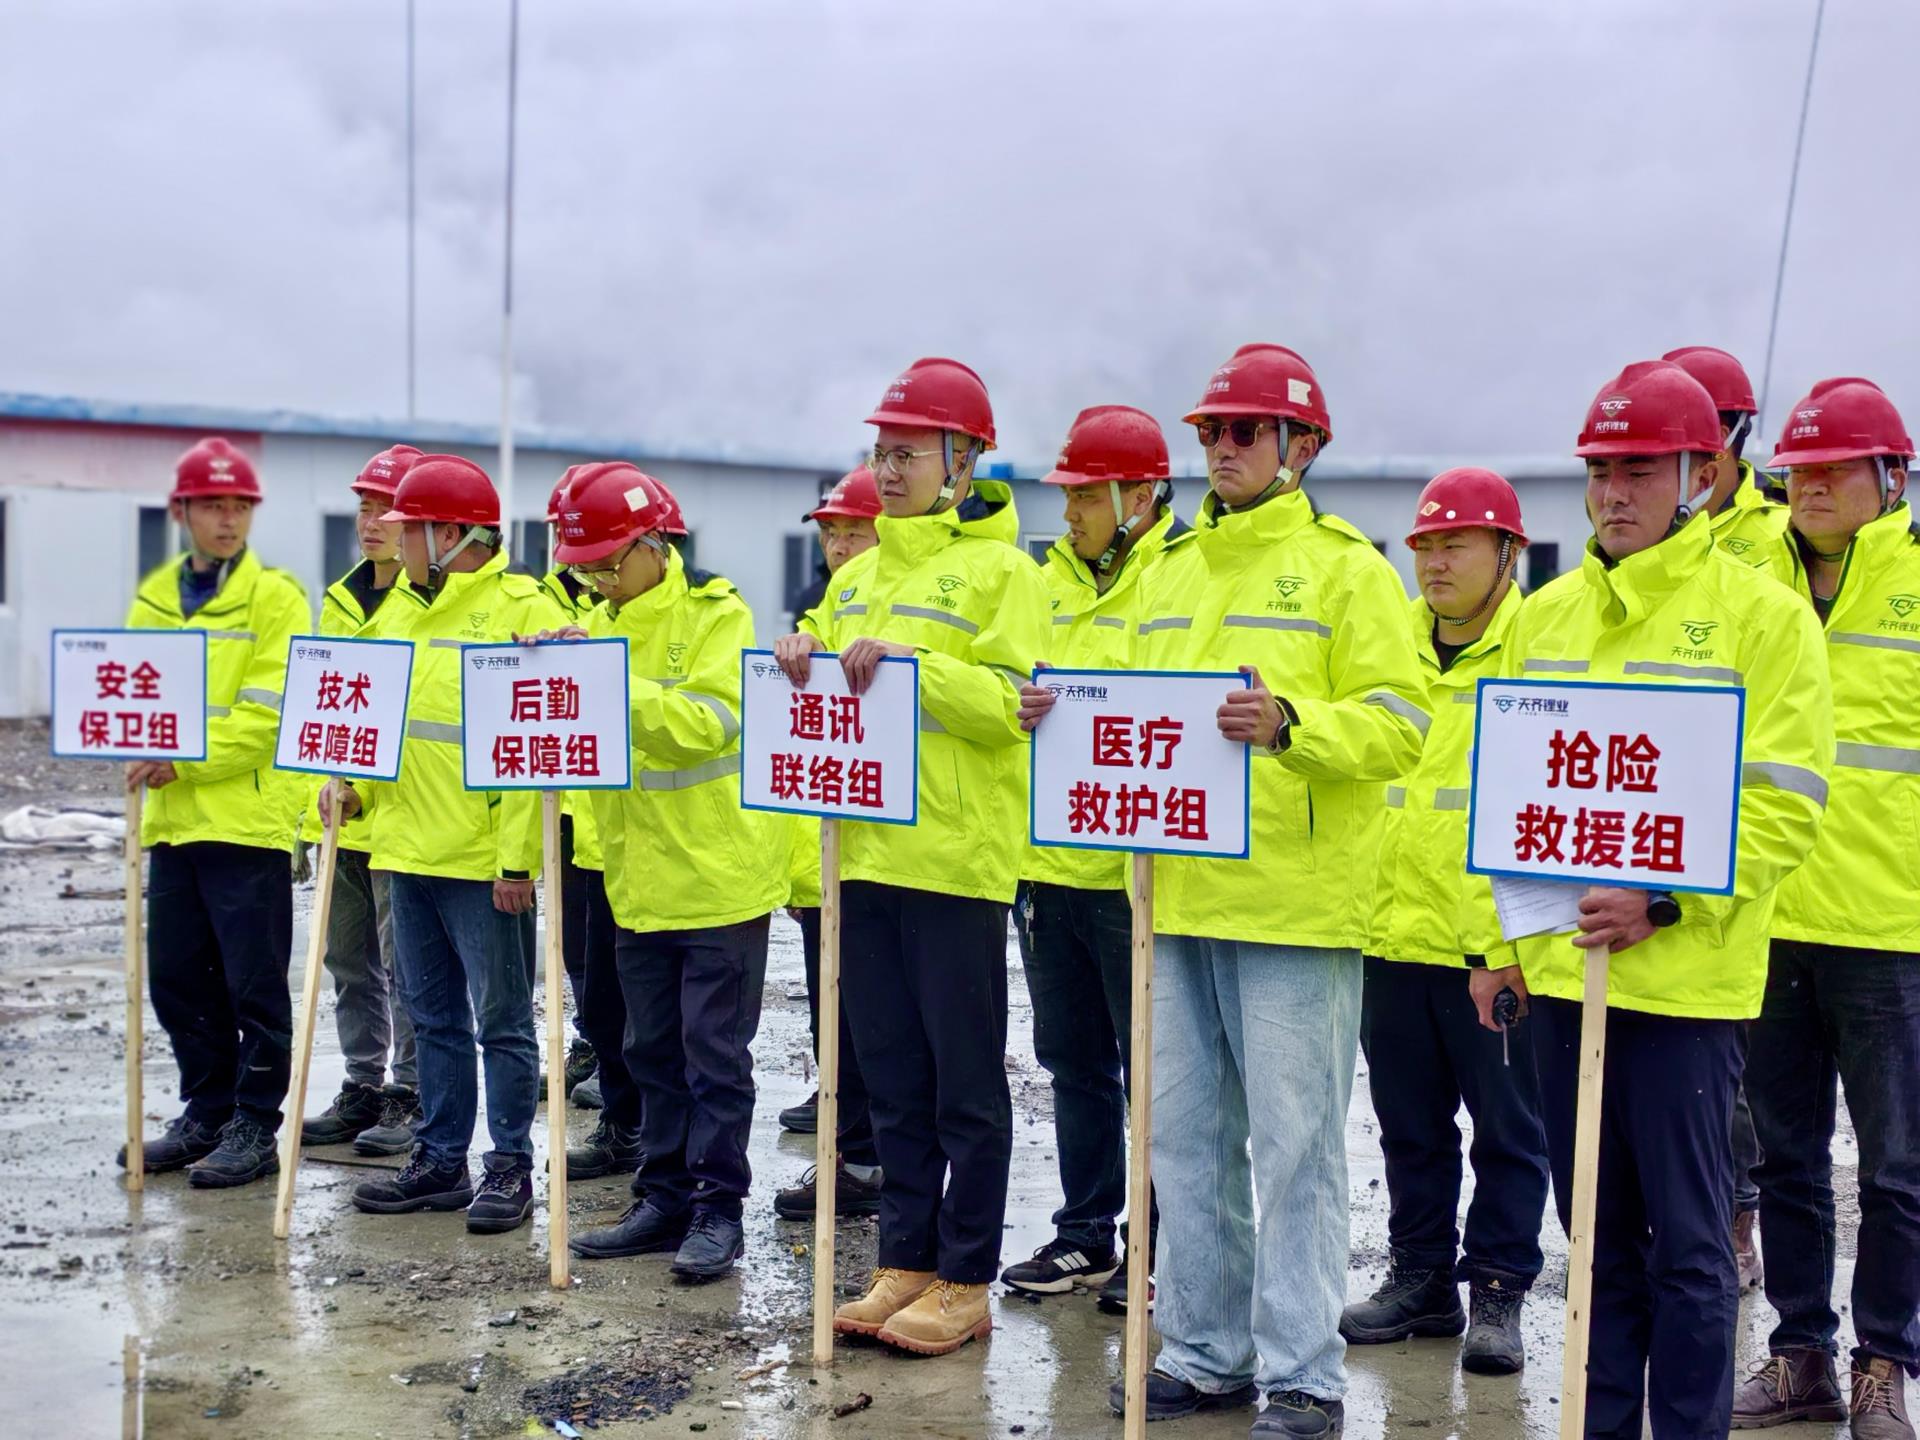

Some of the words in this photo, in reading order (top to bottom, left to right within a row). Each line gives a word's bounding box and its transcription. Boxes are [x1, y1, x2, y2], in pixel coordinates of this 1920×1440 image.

[96, 661, 161, 699] 安全
[316, 670, 371, 714] 技术
[510, 677, 580, 722] 后勤
[1065, 685, 1108, 699] 天齐锂业
[790, 691, 865, 744] 通讯
[1518, 697, 1569, 712] 天齐锂业
[79, 710, 179, 750] 保卫组
[297, 721, 379, 767] 保障组
[1092, 715, 1184, 769] 医疗
[491, 734, 600, 779] 保障组
[1547, 729, 1661, 793] 抢险
[770, 753, 884, 808] 联络组
[1067, 781, 1209, 841] 救护组
[1514, 803, 1686, 873] 救援组
